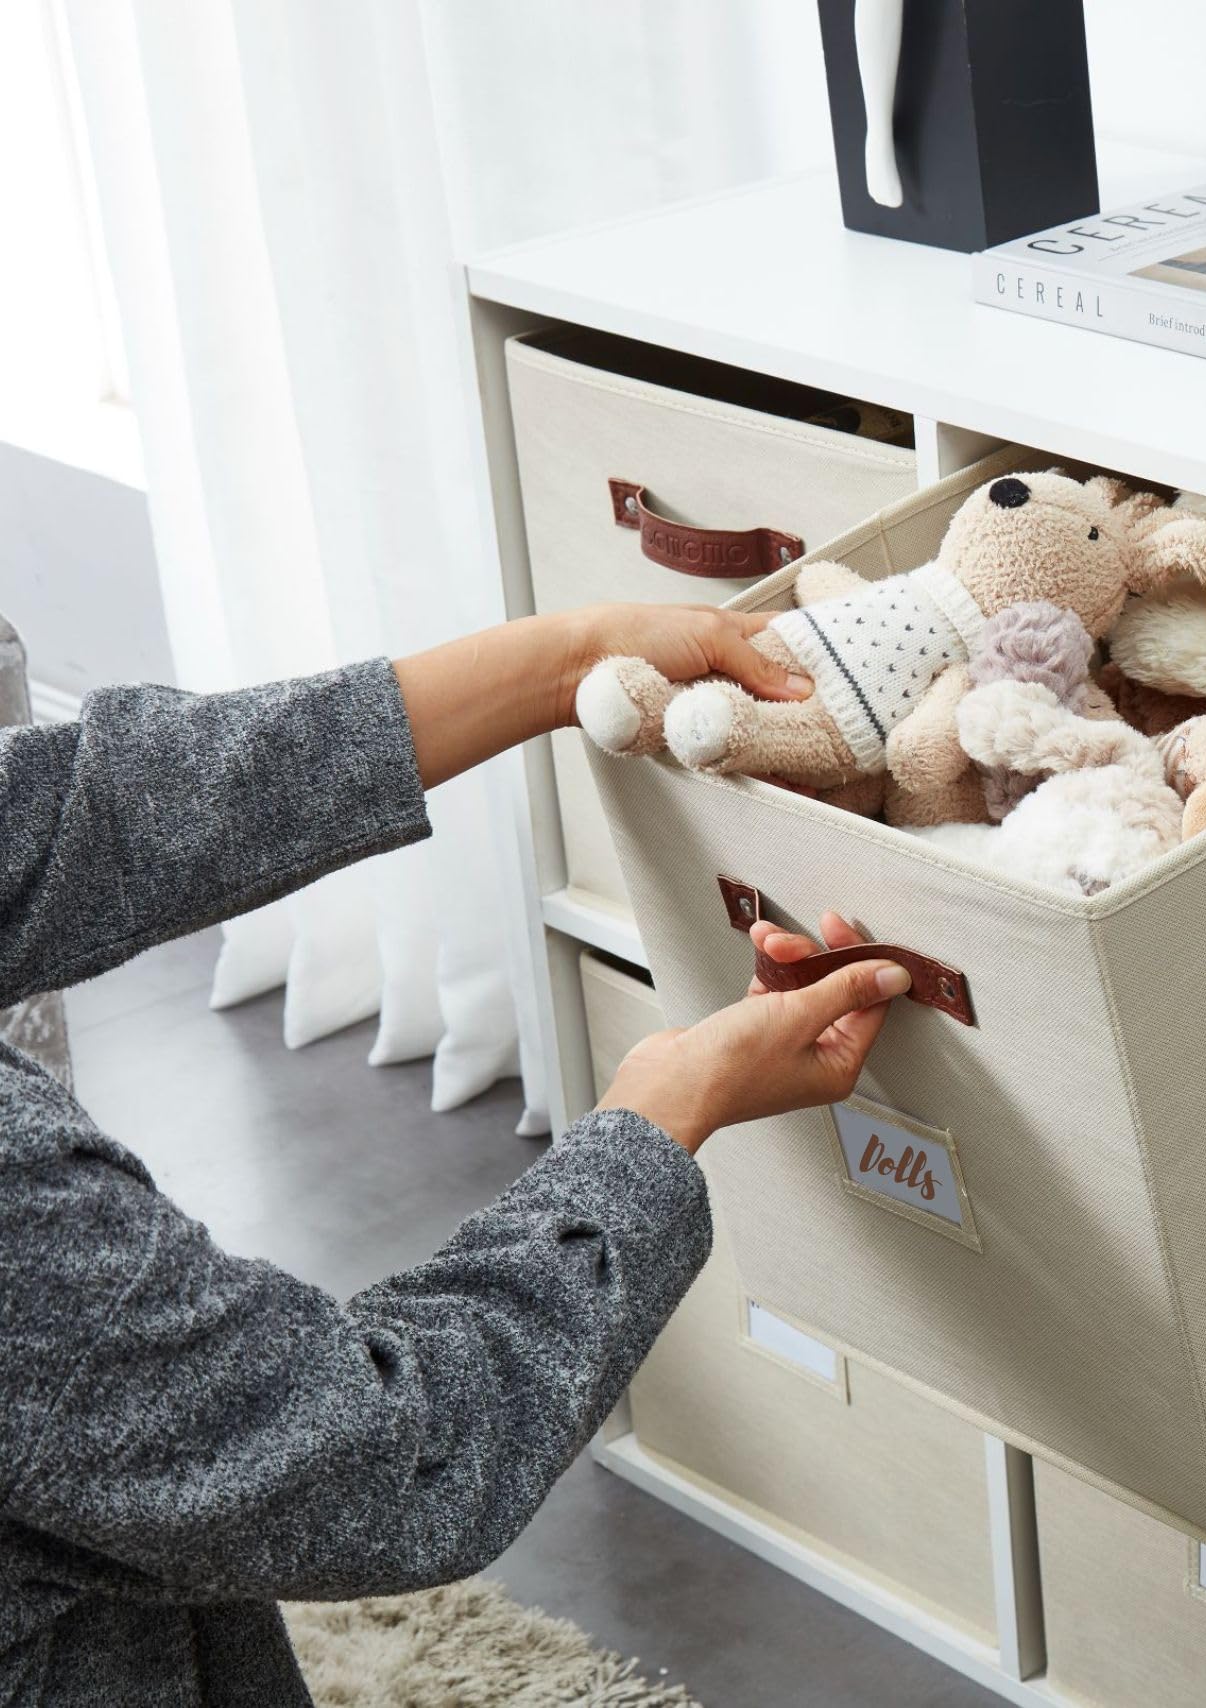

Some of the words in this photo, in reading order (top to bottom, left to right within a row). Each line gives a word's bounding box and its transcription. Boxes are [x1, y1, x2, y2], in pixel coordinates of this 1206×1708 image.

[996, 272, 1103, 318] CEREAL
[1149, 312, 1173, 329] Brief
[859, 1133, 944, 1200] Dolls
